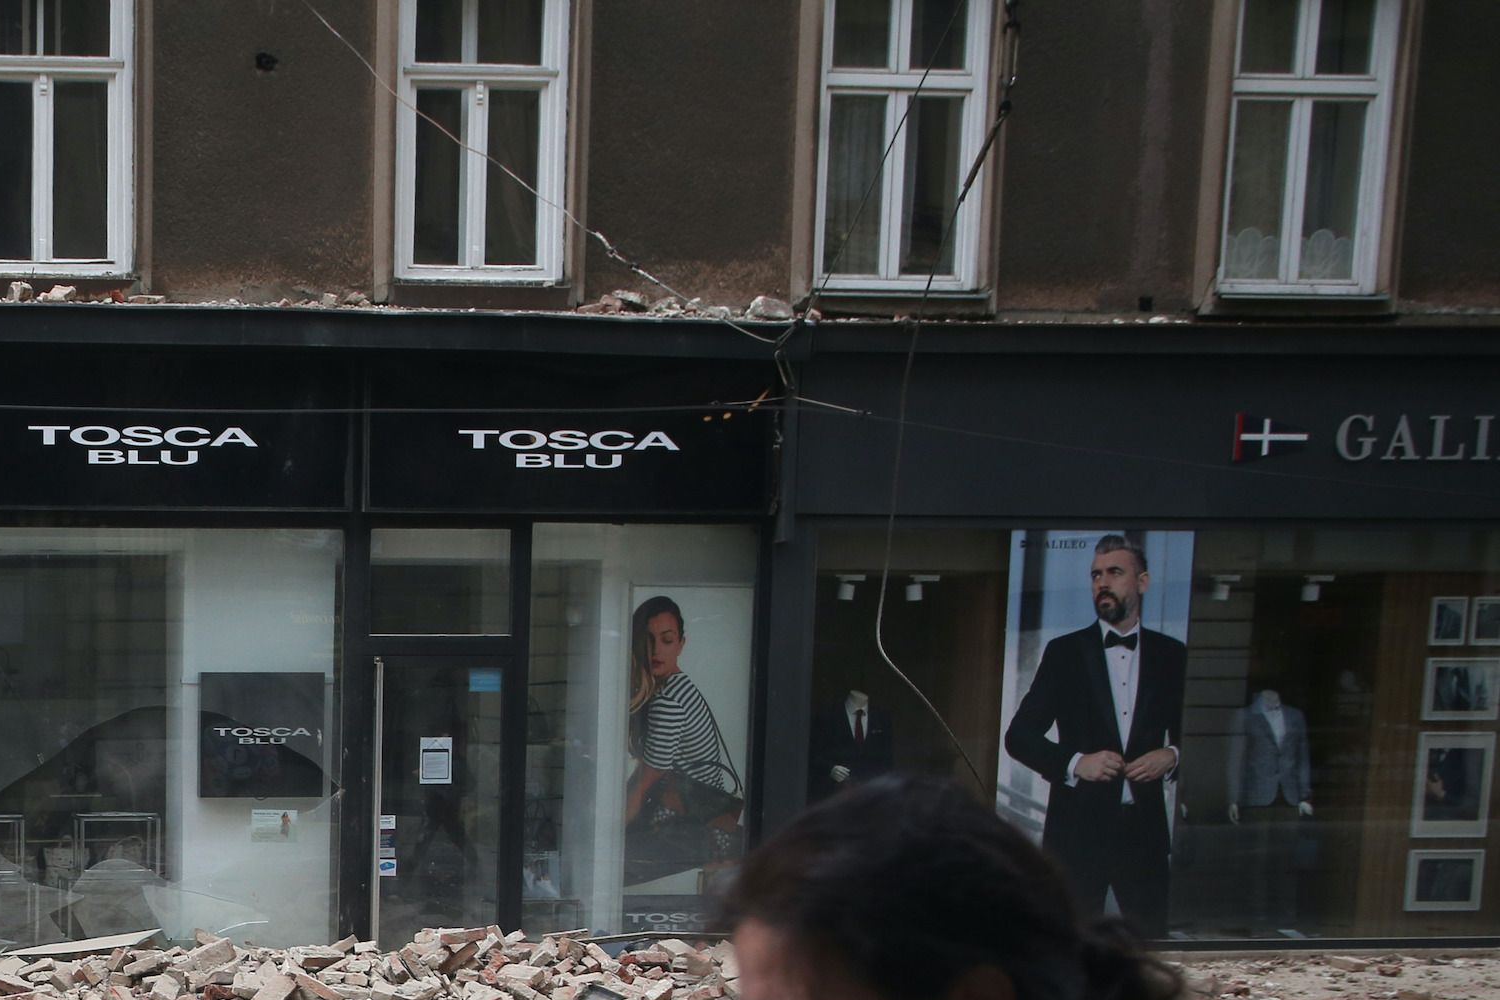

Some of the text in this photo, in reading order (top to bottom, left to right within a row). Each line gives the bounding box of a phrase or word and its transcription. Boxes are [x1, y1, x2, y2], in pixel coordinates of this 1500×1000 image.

[27, 425, 258, 447] TOSCA
[458, 429, 680, 451] TOSCA
[1335, 413, 1500, 461] GALI
[88, 449, 198, 465] BLU
[516, 453, 622, 469] BLU
[213, 727, 311, 737] TOSCA
[238, 737, 287, 745] BLU
[626, 912, 711, 924] TOSC
